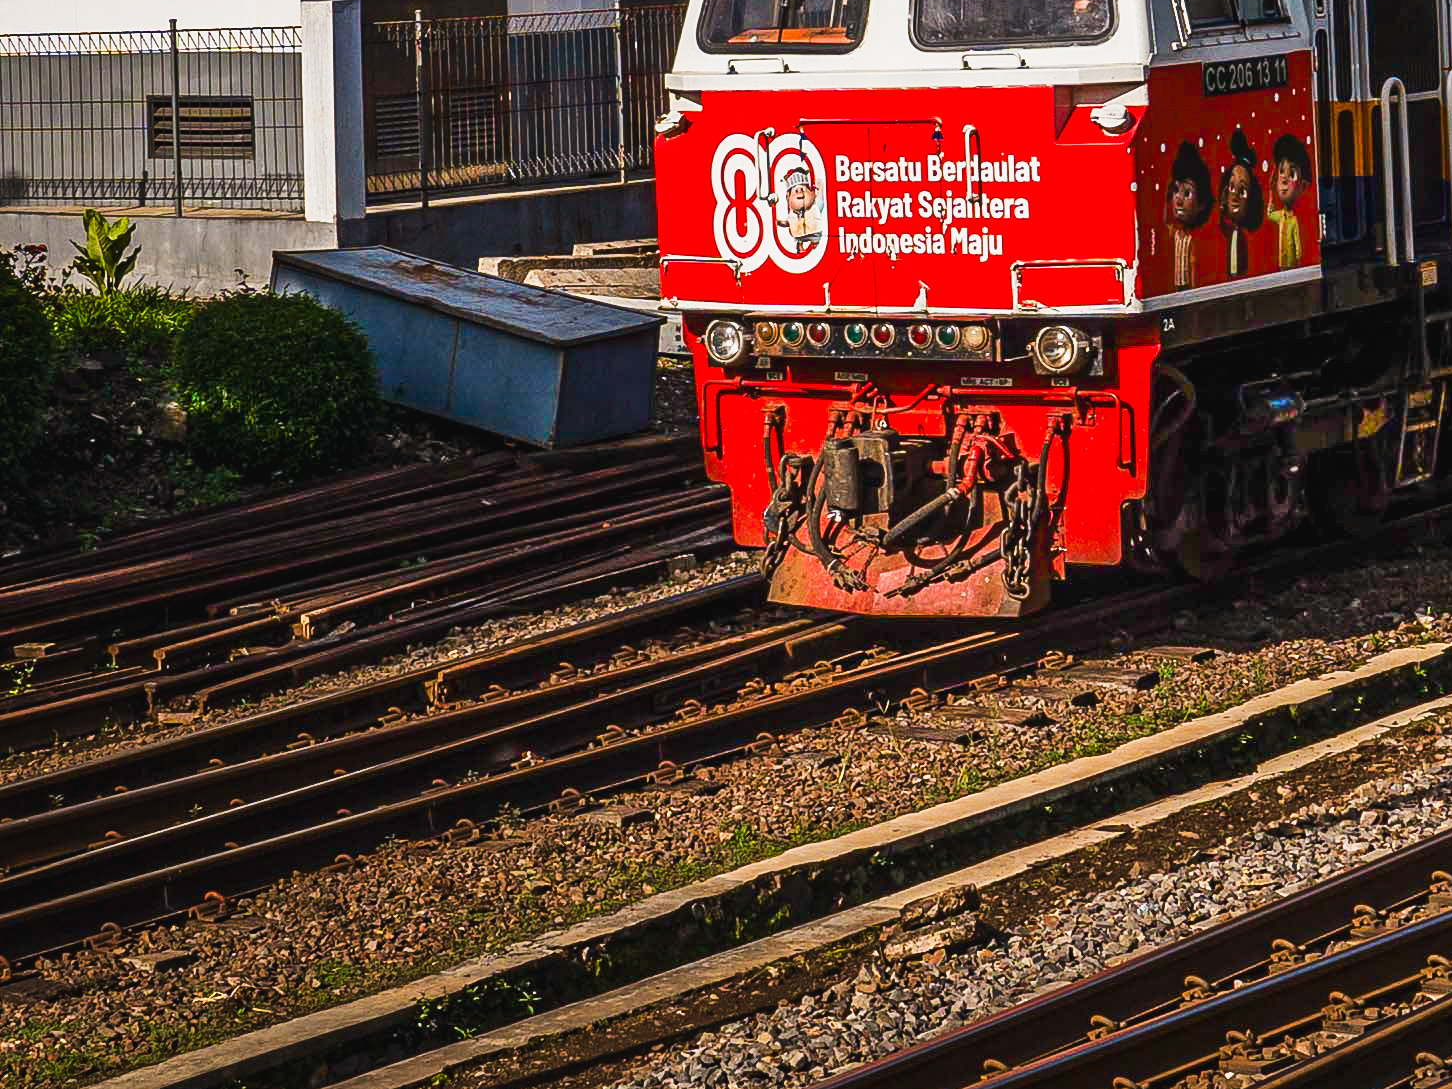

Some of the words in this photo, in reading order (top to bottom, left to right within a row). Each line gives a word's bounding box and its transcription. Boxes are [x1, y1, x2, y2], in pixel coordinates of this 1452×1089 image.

[1206, 66, 1226, 91] CC
[1230, 62, 1253, 89] 206
[1257, 59, 1271, 85] 13
[1275, 57, 1287, 82] 11
[835, 155, 922, 182] Bersatu
[927, 154, 1041, 182] Berdaulat
[711, 133, 829, 274] 80
[836, 191, 913, 224] Rakyat
[918, 190, 1030, 225] Sejahtera
[838, 226, 946, 254] Indonesia
[950, 227, 1003, 262] Maju
